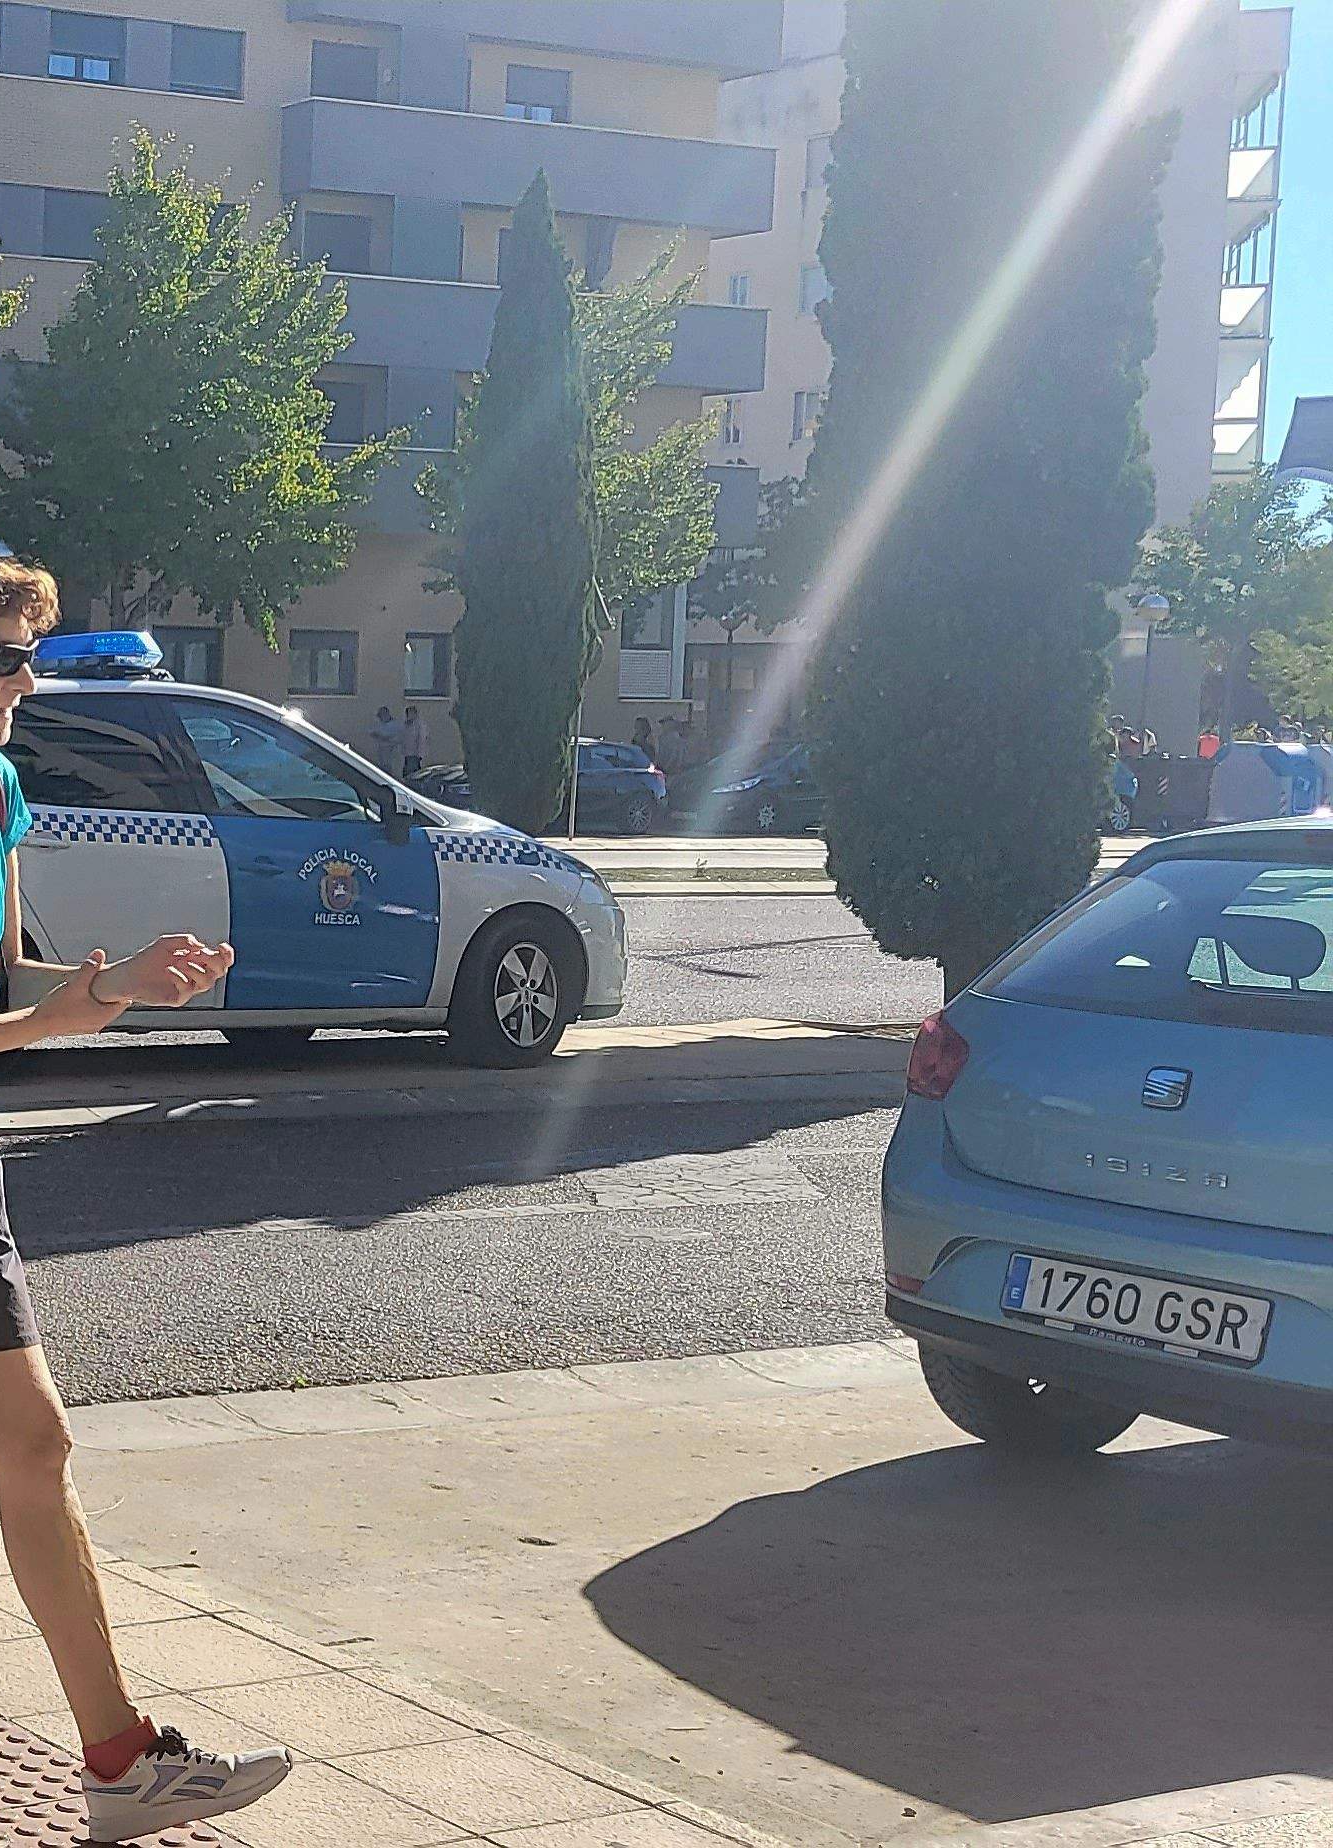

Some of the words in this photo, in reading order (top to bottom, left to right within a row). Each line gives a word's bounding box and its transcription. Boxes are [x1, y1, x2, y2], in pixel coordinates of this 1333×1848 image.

[298, 847, 338, 881] POLICIA
[343, 849, 378, 885] LOCAL
[314, 913, 361, 926] HUESCA
[1040, 1267, 1142, 1326] 1760
[1154, 1291, 1249, 1350] GSR
